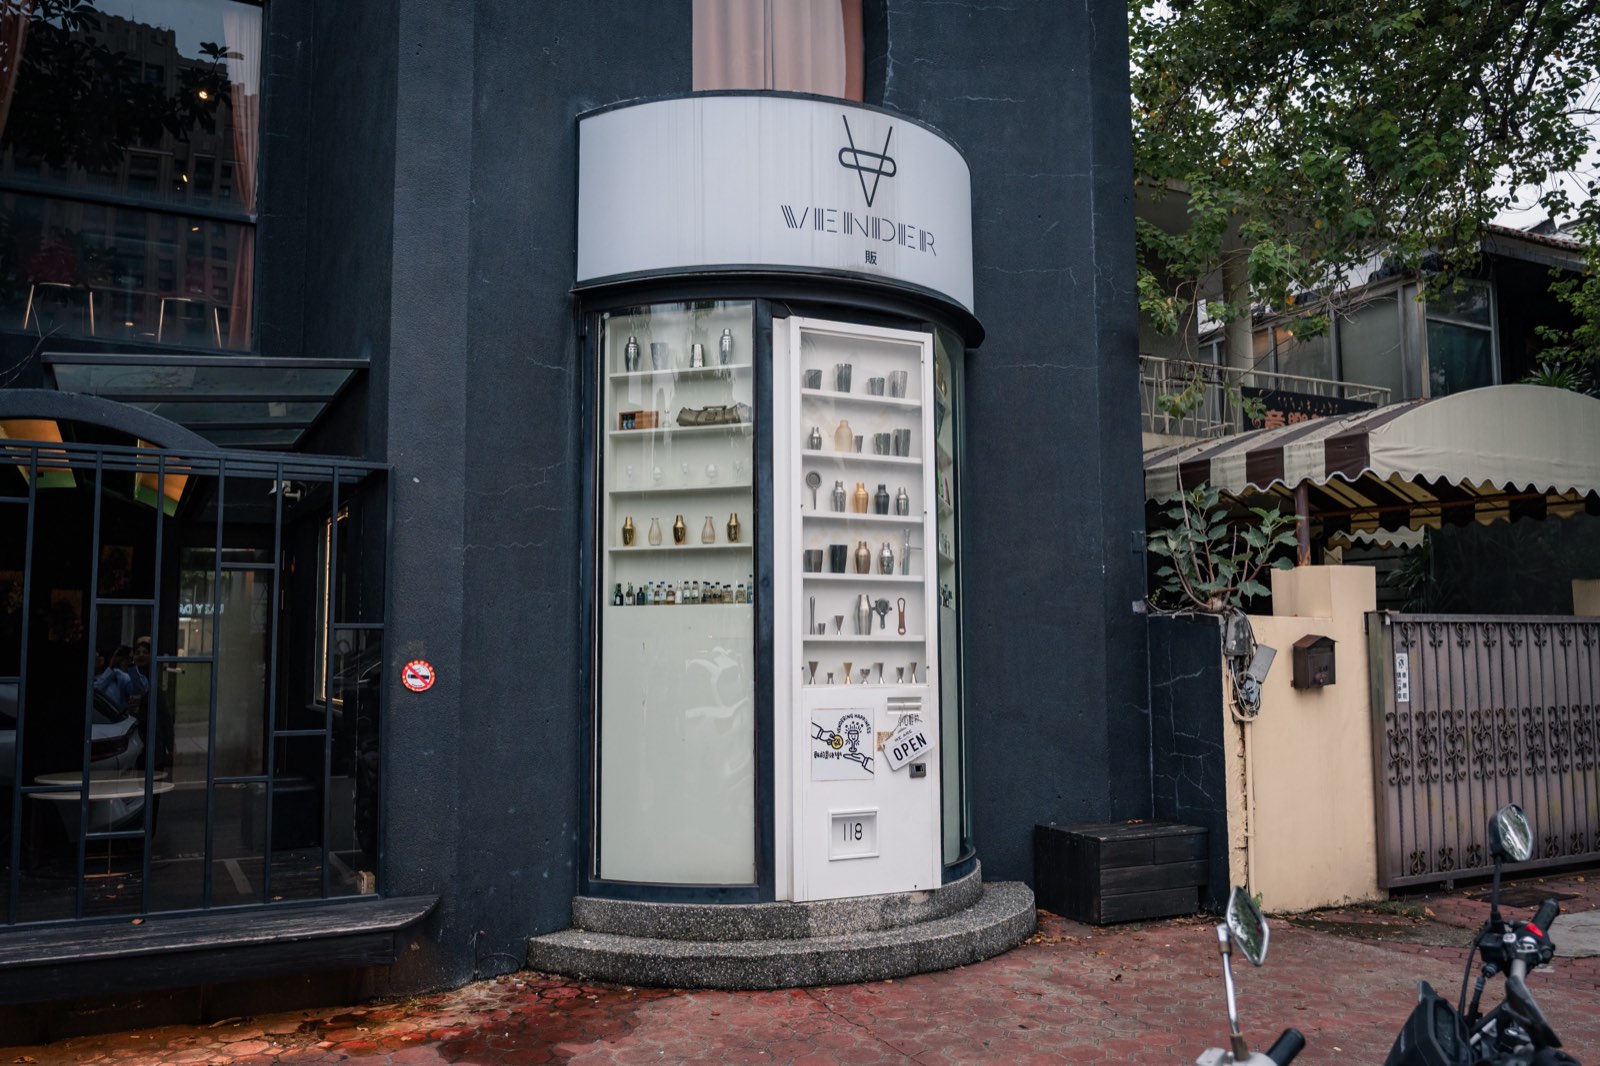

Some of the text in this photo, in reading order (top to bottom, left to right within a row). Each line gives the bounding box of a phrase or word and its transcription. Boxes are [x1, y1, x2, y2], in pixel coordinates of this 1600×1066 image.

[781, 204, 937, 257] VENDER
[865, 250, 878, 266] 販
[854, 713, 872, 735] HAPPINESS
[893, 732, 928, 761] OPEN
[843, 822, 863, 841] 118
